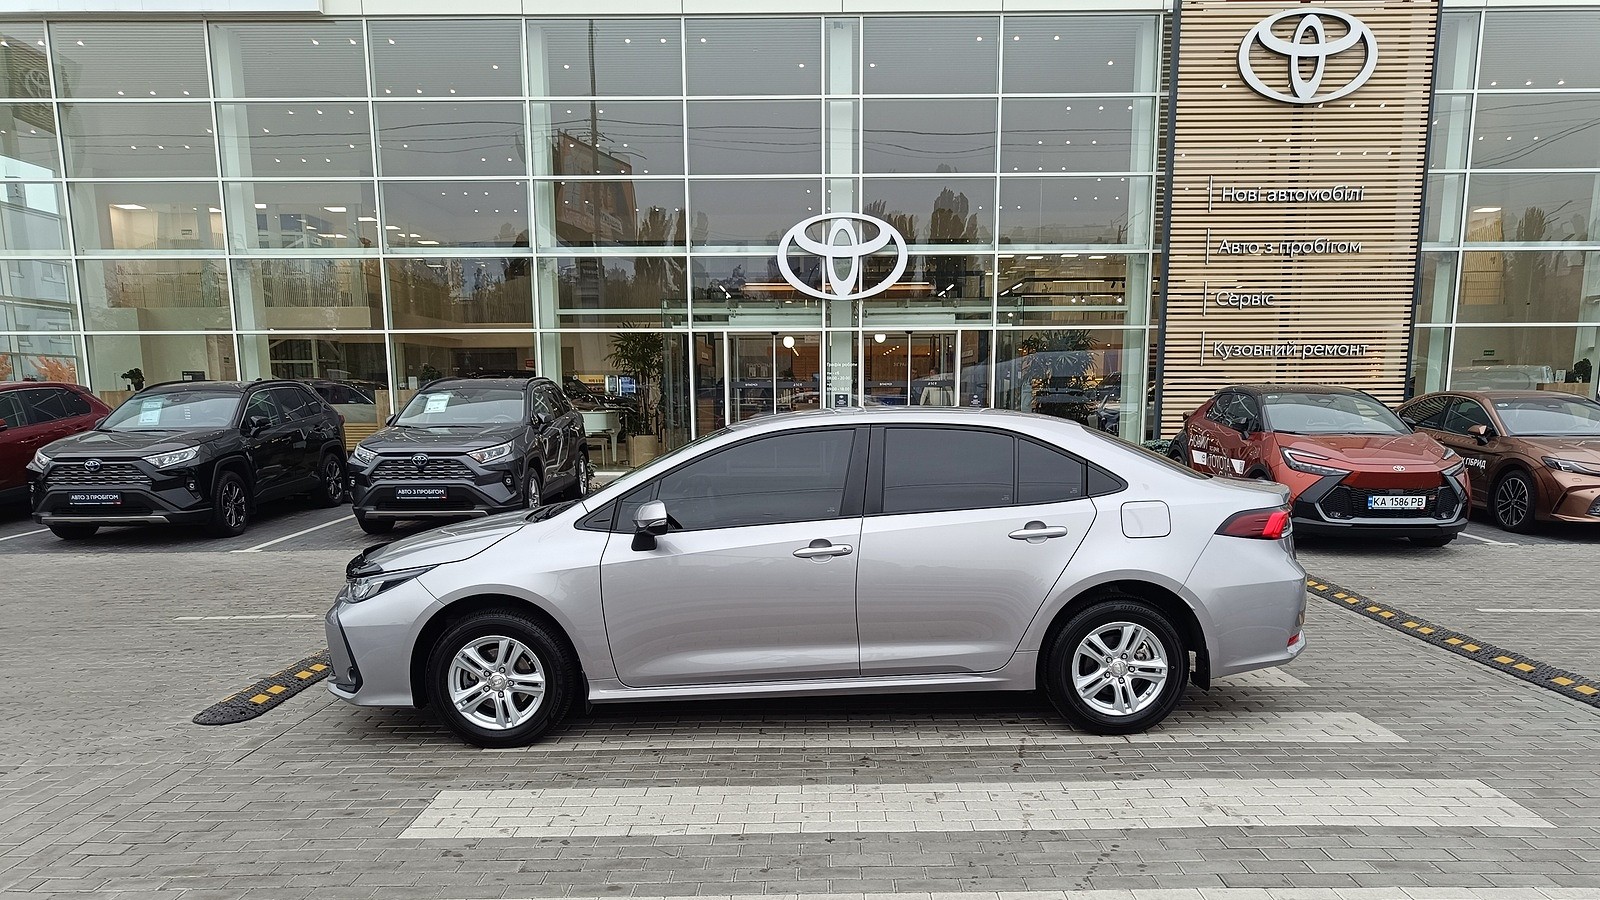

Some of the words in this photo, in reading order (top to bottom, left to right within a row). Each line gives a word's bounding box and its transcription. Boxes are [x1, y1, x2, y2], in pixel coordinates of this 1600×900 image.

[1222, 186, 1262, 202] Нові
[1266, 185, 1365, 202] автомобілі
[1218, 239, 1260, 254] Авто
[1264, 243, 1274, 254] з
[1279, 238, 1362, 258] пробігом
[1215, 291, 1275, 310] Сервіс
[1212, 341, 1298, 360] Кузовний
[1302, 343, 1369, 360] ремонт
[1208, 453, 1231, 471] TOYOTA
[1465, 457, 1487, 469] ГІБРИД
[1373, 497, 1387, 507] KA
[1390, 497, 1409, 507] 1586
[1410, 497, 1424, 507] PB
